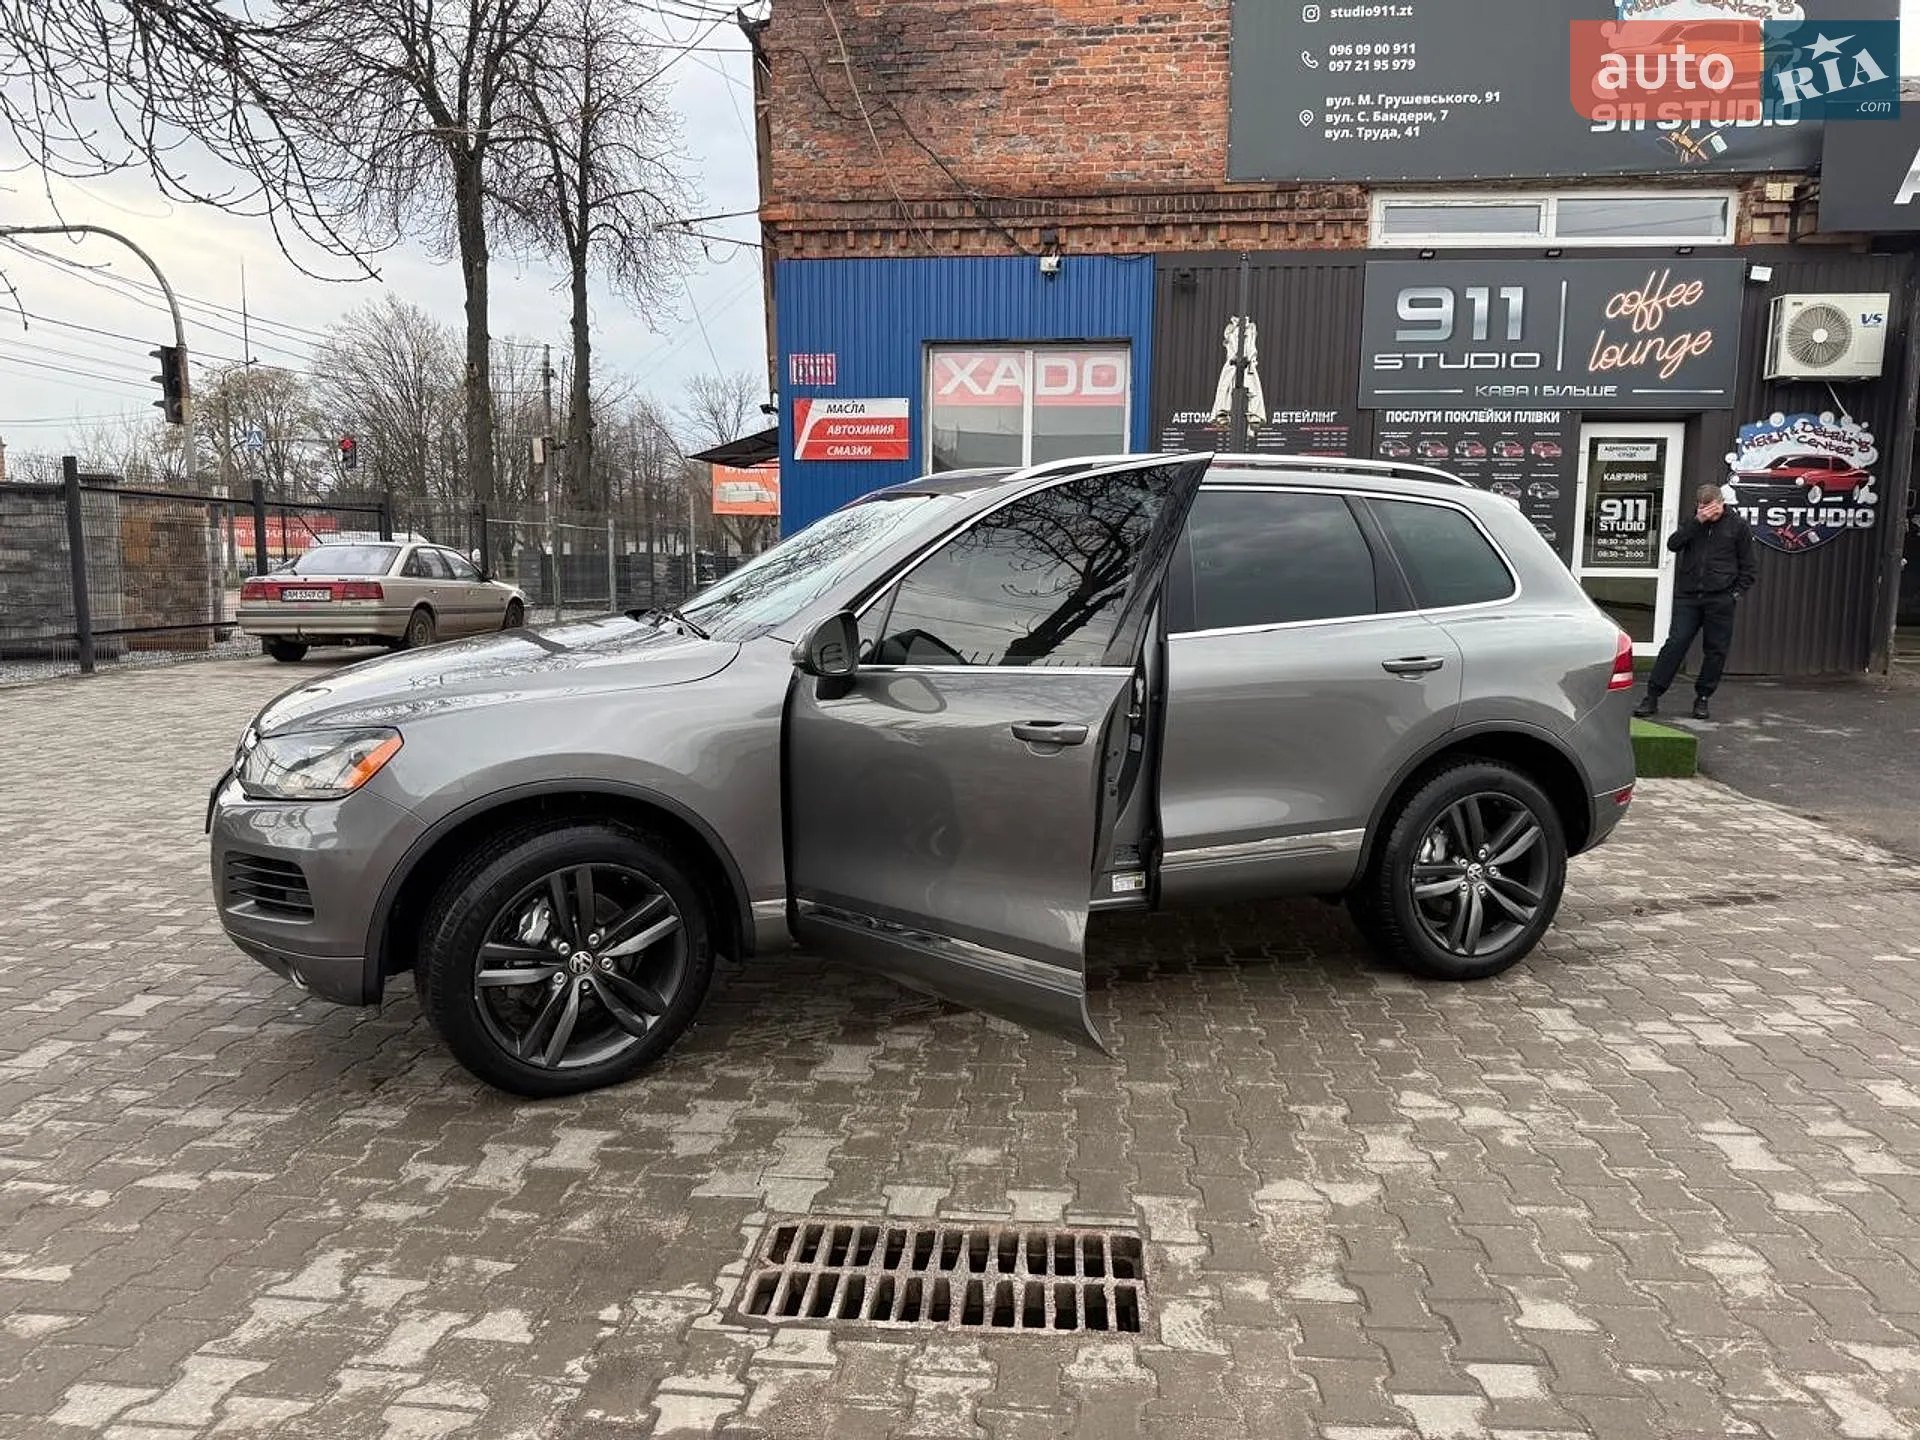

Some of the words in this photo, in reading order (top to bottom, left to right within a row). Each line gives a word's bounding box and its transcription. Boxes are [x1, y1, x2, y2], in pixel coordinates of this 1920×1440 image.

[1330, 5, 1413, 19] studio911.zt
[1329, 44, 1352, 56] 096
[1356, 44, 1371, 56] 09
[1374, 44, 1390, 55] 00
[1393, 43, 1416, 54] 911
[1329, 60, 1351, 72] 097
[1354, 60, 1370, 71] 21
[1373, 59, 1389, 71] 95
[1392, 59, 1416, 71] 979
[1326, 96, 1355, 110] вул.
[1357, 95, 1374, 106] М.
[1378, 92, 1482, 110] Грушевського,
[1485, 91, 1501, 103] 91
[1325, 112, 1353, 127] вул.
[1357, 111, 1369, 122] С.
[1372, 110, 1437, 125] Бандери,
[1440, 109, 1449, 121] 7
[1590, 102, 1646, 132] 911
[1655, 97, 1801, 131] STUDIO
[1325, 128, 1353, 142] вул.
[1356, 126, 1401, 142] Труда,
[1404, 126, 1420, 138] 41
[1605, 268, 1704, 333] coffee
[1396, 286, 1524, 342] 911
[1860, 313, 1883, 326] VS
[1373, 352, 1541, 370] STUDIO
[1589, 329, 1713, 380] lounge
[938, 357, 1125, 396] XADO
[1475, 385, 1530, 398] КАВА
[1543, 384, 1619, 398] БІЛЬШЕ
[826, 403, 866, 414] МАСЛА
[1272, 409, 1338, 424] ДЕТЕЙЛІНГ
[1386, 410, 1442, 424] ПОСЛУГИ
[1445, 408, 1511, 424] ПОКЛЕЙКИ
[1514, 411, 1560, 424] ПЛІВКИ
[1172, 412, 1213, 424] АВТОМ
[826, 424, 895, 436] АВТОХИМИЯ
[826, 445, 872, 457] СМАЗКИ
[1600, 499, 1647, 521] 911
[1739, 507, 1759, 526] 11
[1767, 507, 1875, 528] STUDIO
[1599, 520, 1646, 531] STUDIO
